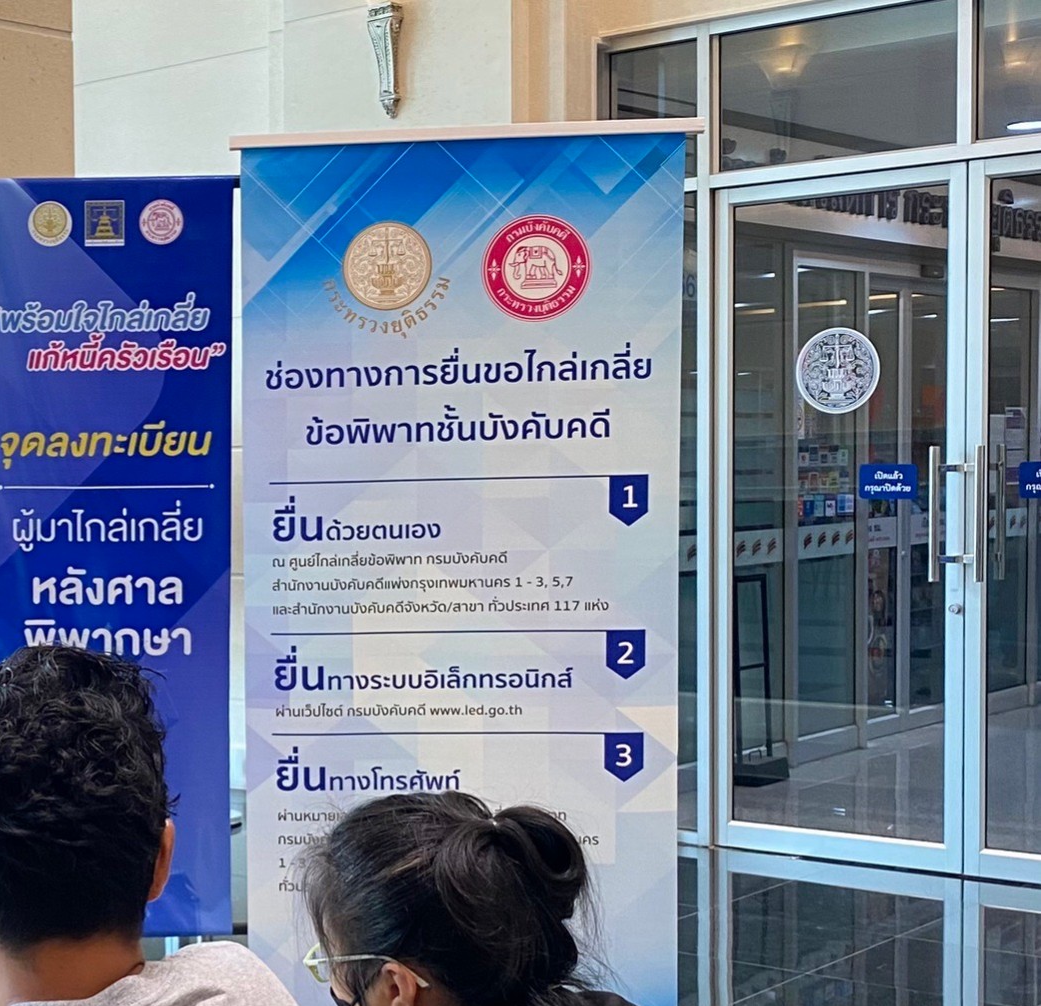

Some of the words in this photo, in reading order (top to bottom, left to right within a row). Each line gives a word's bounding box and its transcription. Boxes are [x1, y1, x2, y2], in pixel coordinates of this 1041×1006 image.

[323, 277, 451, 339] กระทรวงยุติธรรม
[264, 342, 653, 390] ช่องทางการยื่นขอไกล่เกลี่ย
[0, 420, 212, 469] จุดลงทะเบียน
[305, 405, 611, 446] ข้อพิพาทชั้นบังคับคดี
[622, 485, 638, 508] 1
[13, 499, 203, 552] ผู้มาไกล่เกลี่ย
[272, 496, 441, 542] ยื่นด้วยตนเอง
[272, 556, 285, 568] ณ
[289, 550, 422, 571] ศูนย์ไกล่เกลี่ยข้อพิพาท
[426, 550, 508, 566] กรมบังคับคดี
[32, 566, 183, 605] หลังศาล
[515, 576, 522, 587] 1
[488, 596, 549, 613] ทั่วประเทศ
[554, 600, 580, 612] 117
[584, 598, 609, 612] แห่ง
[274, 646, 573, 691] ยื่นทางระบบอิเล็กทรอนิกส์
[616, 641, 634, 665] 2
[347, 703, 426, 718] กรมบังคับคดี
[430, 704, 523, 718] www.led.go.th
[615, 743, 632, 767] 3
